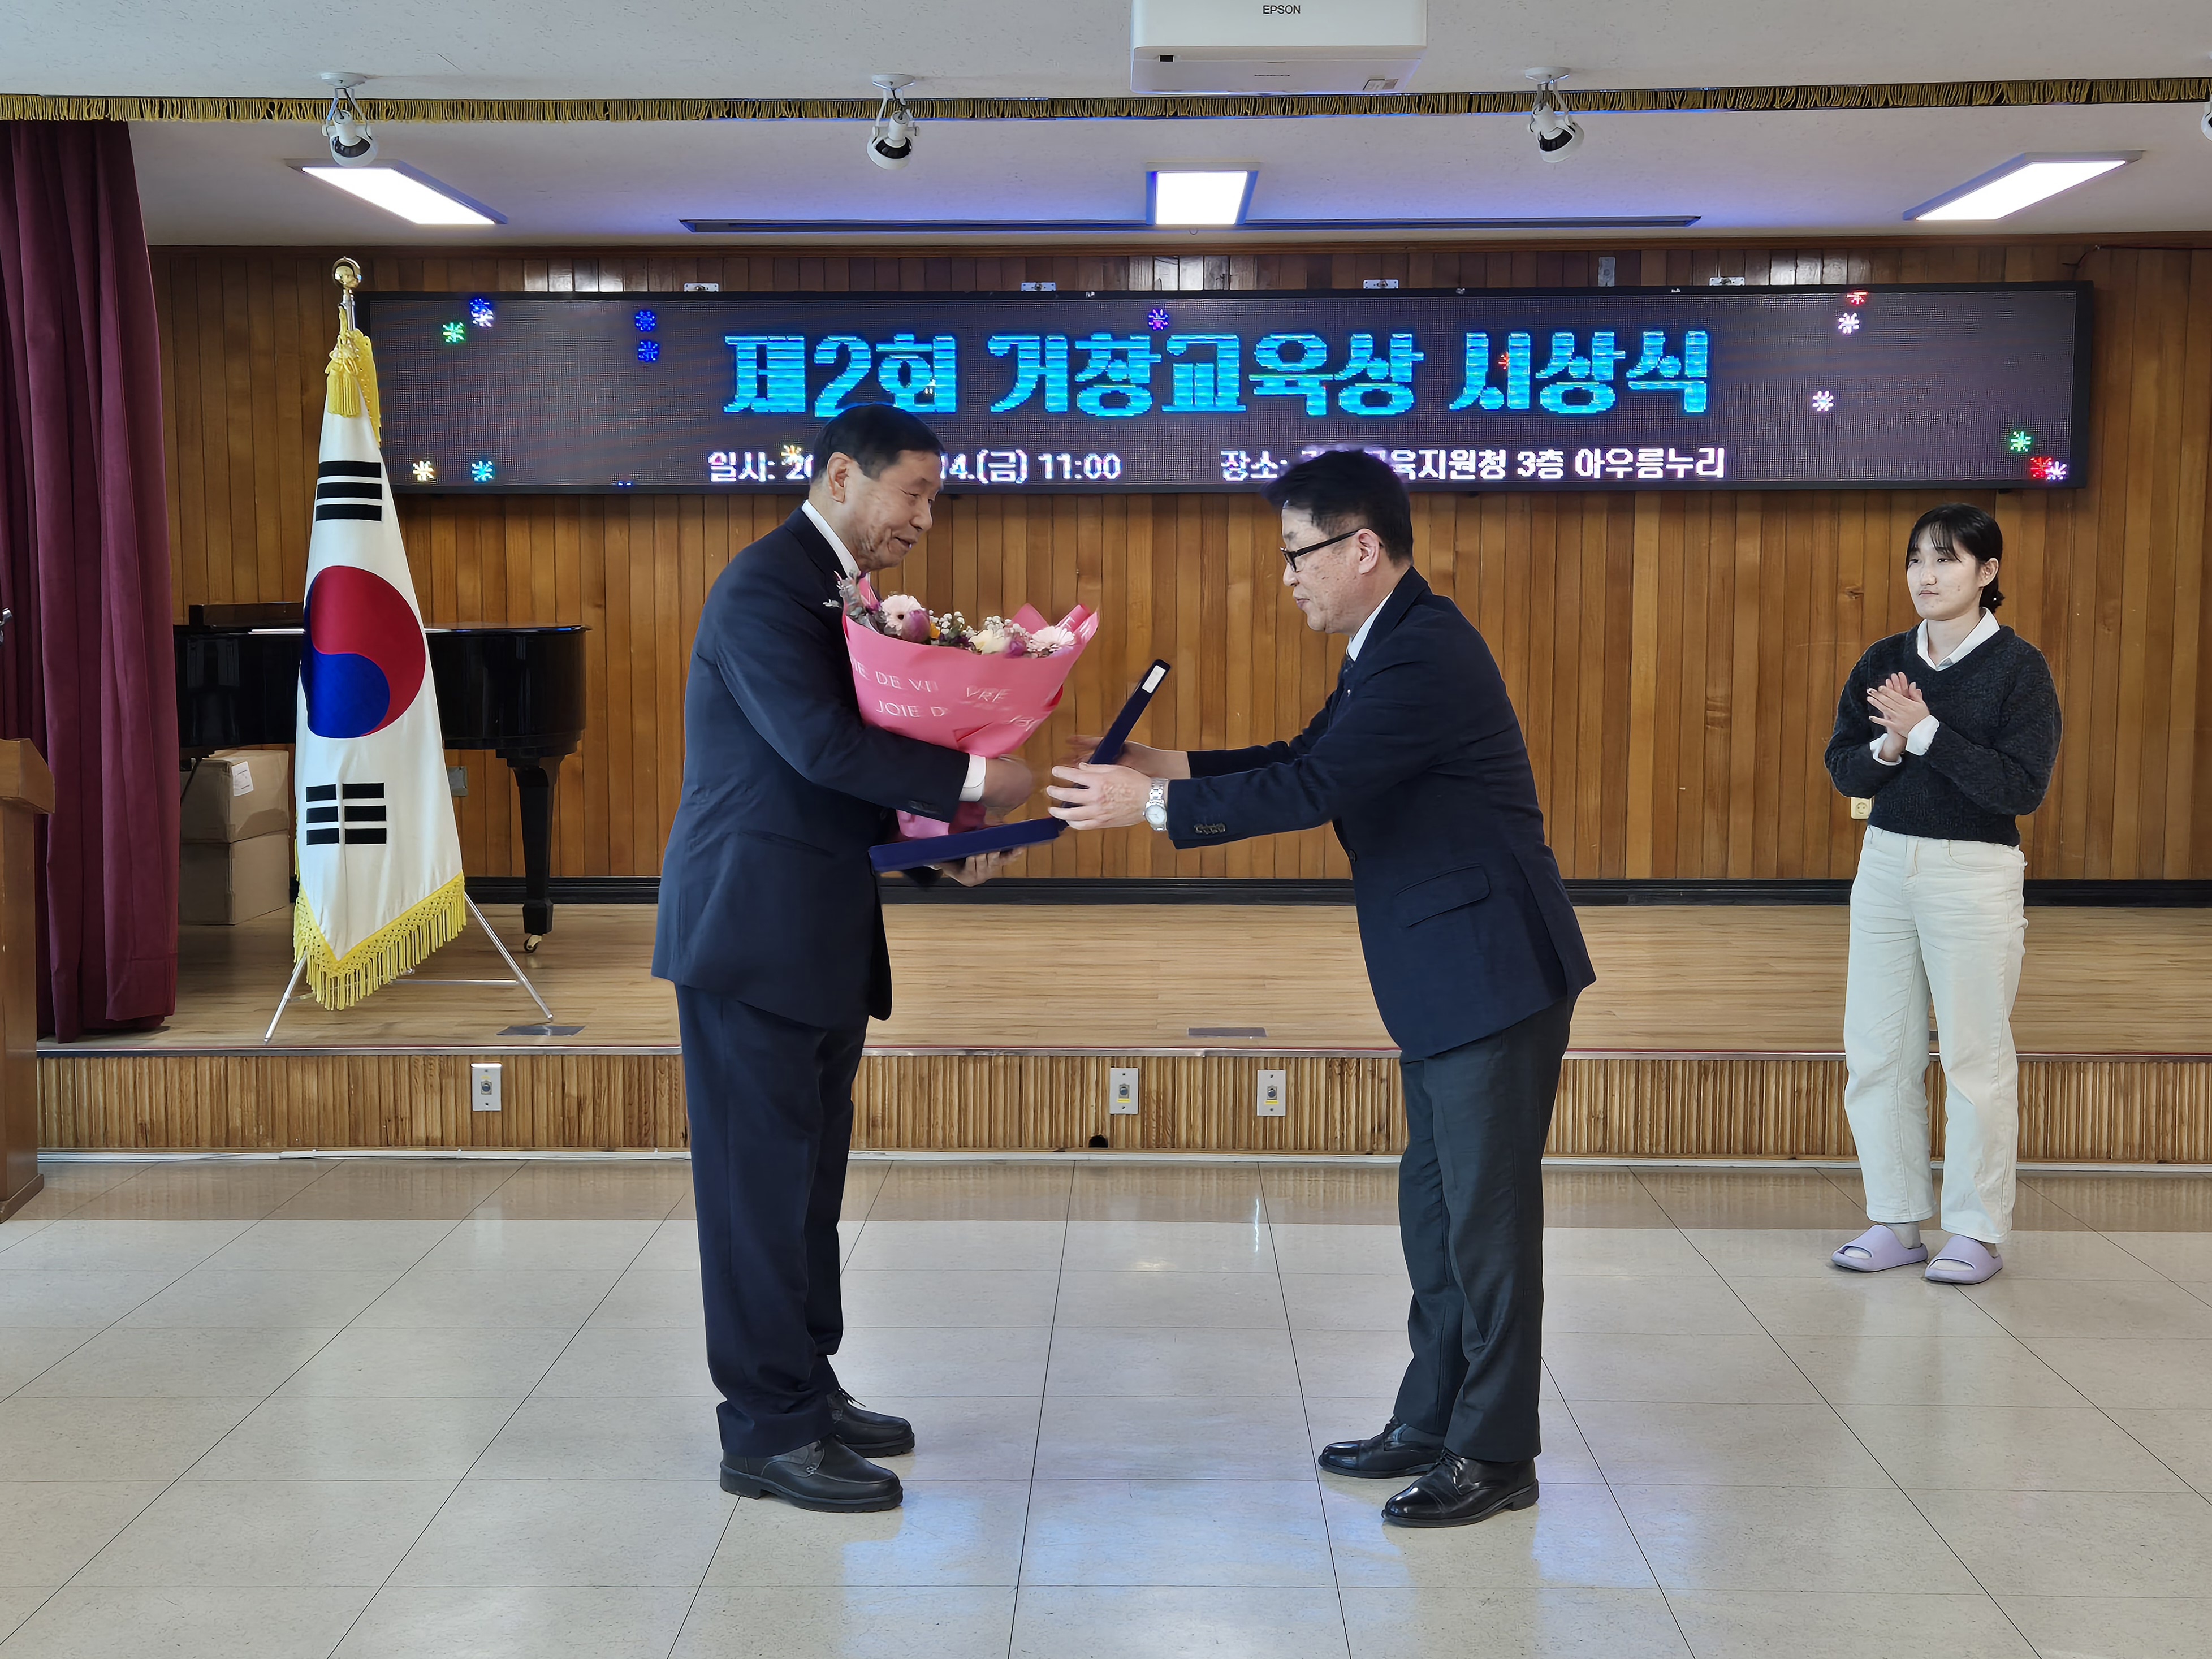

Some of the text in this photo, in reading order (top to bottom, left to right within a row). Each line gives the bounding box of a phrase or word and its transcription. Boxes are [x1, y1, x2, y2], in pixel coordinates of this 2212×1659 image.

[1262, 5, 1301, 15] EPSON
[723, 331, 1708, 418] 제2회 거창교육상 시상식
[708, 451, 775, 482] 일시:
[1038, 453, 1122, 479] 11:00
[1301, 450, 1507, 481] 육지원청
[1517, 448, 1564, 479] 3층
[1574, 447, 1725, 479] 아우름누리
[875, 671, 907, 690] DE
[875, 699, 922, 718] JOIE
